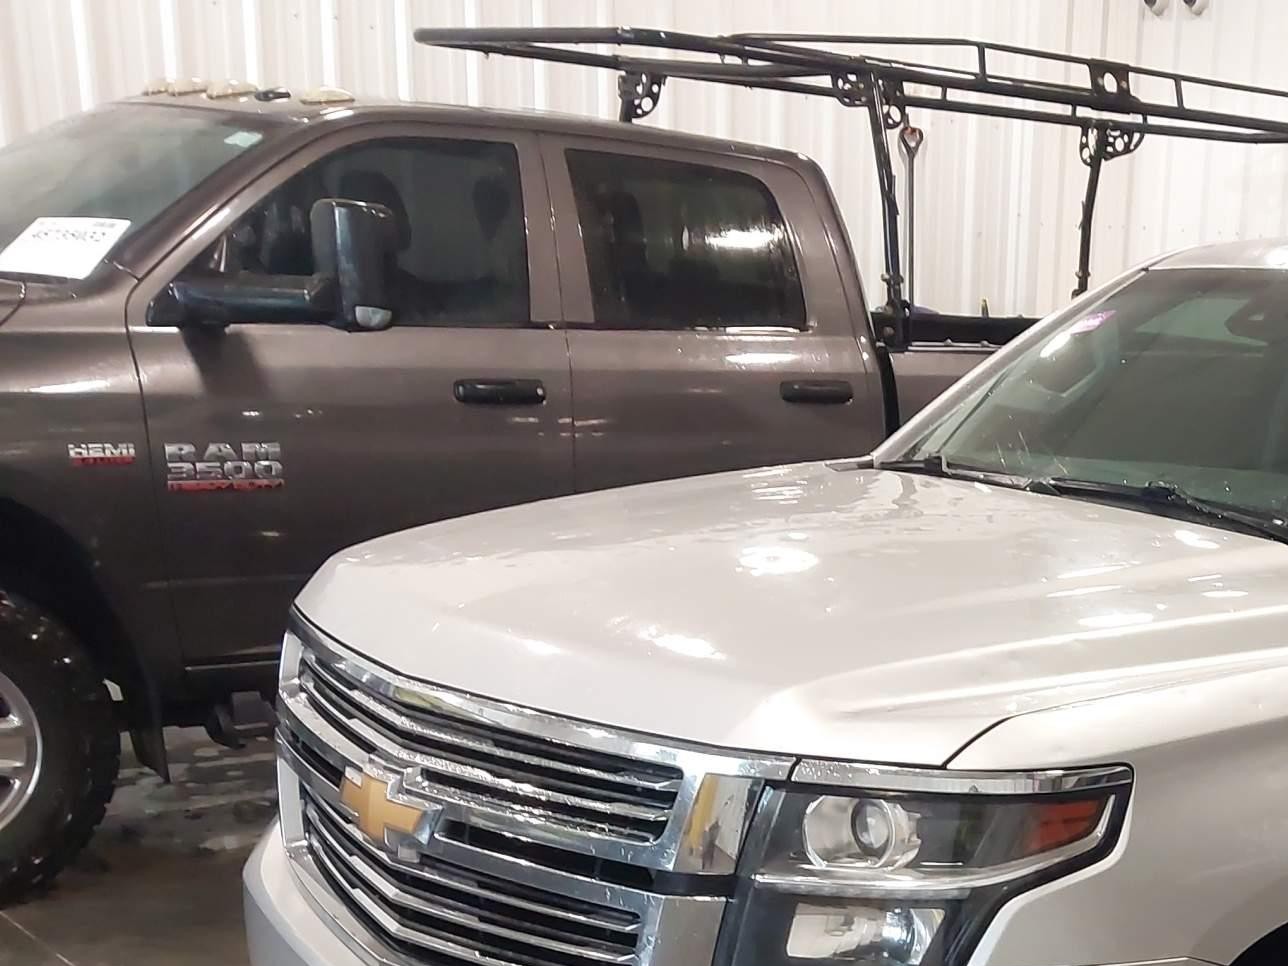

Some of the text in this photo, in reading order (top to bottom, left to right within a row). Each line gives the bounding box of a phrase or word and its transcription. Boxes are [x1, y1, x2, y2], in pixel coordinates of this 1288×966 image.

[68, 442, 136, 458] HEMI
[164, 442, 281, 461] RAM
[167, 461, 284, 480] 3500
